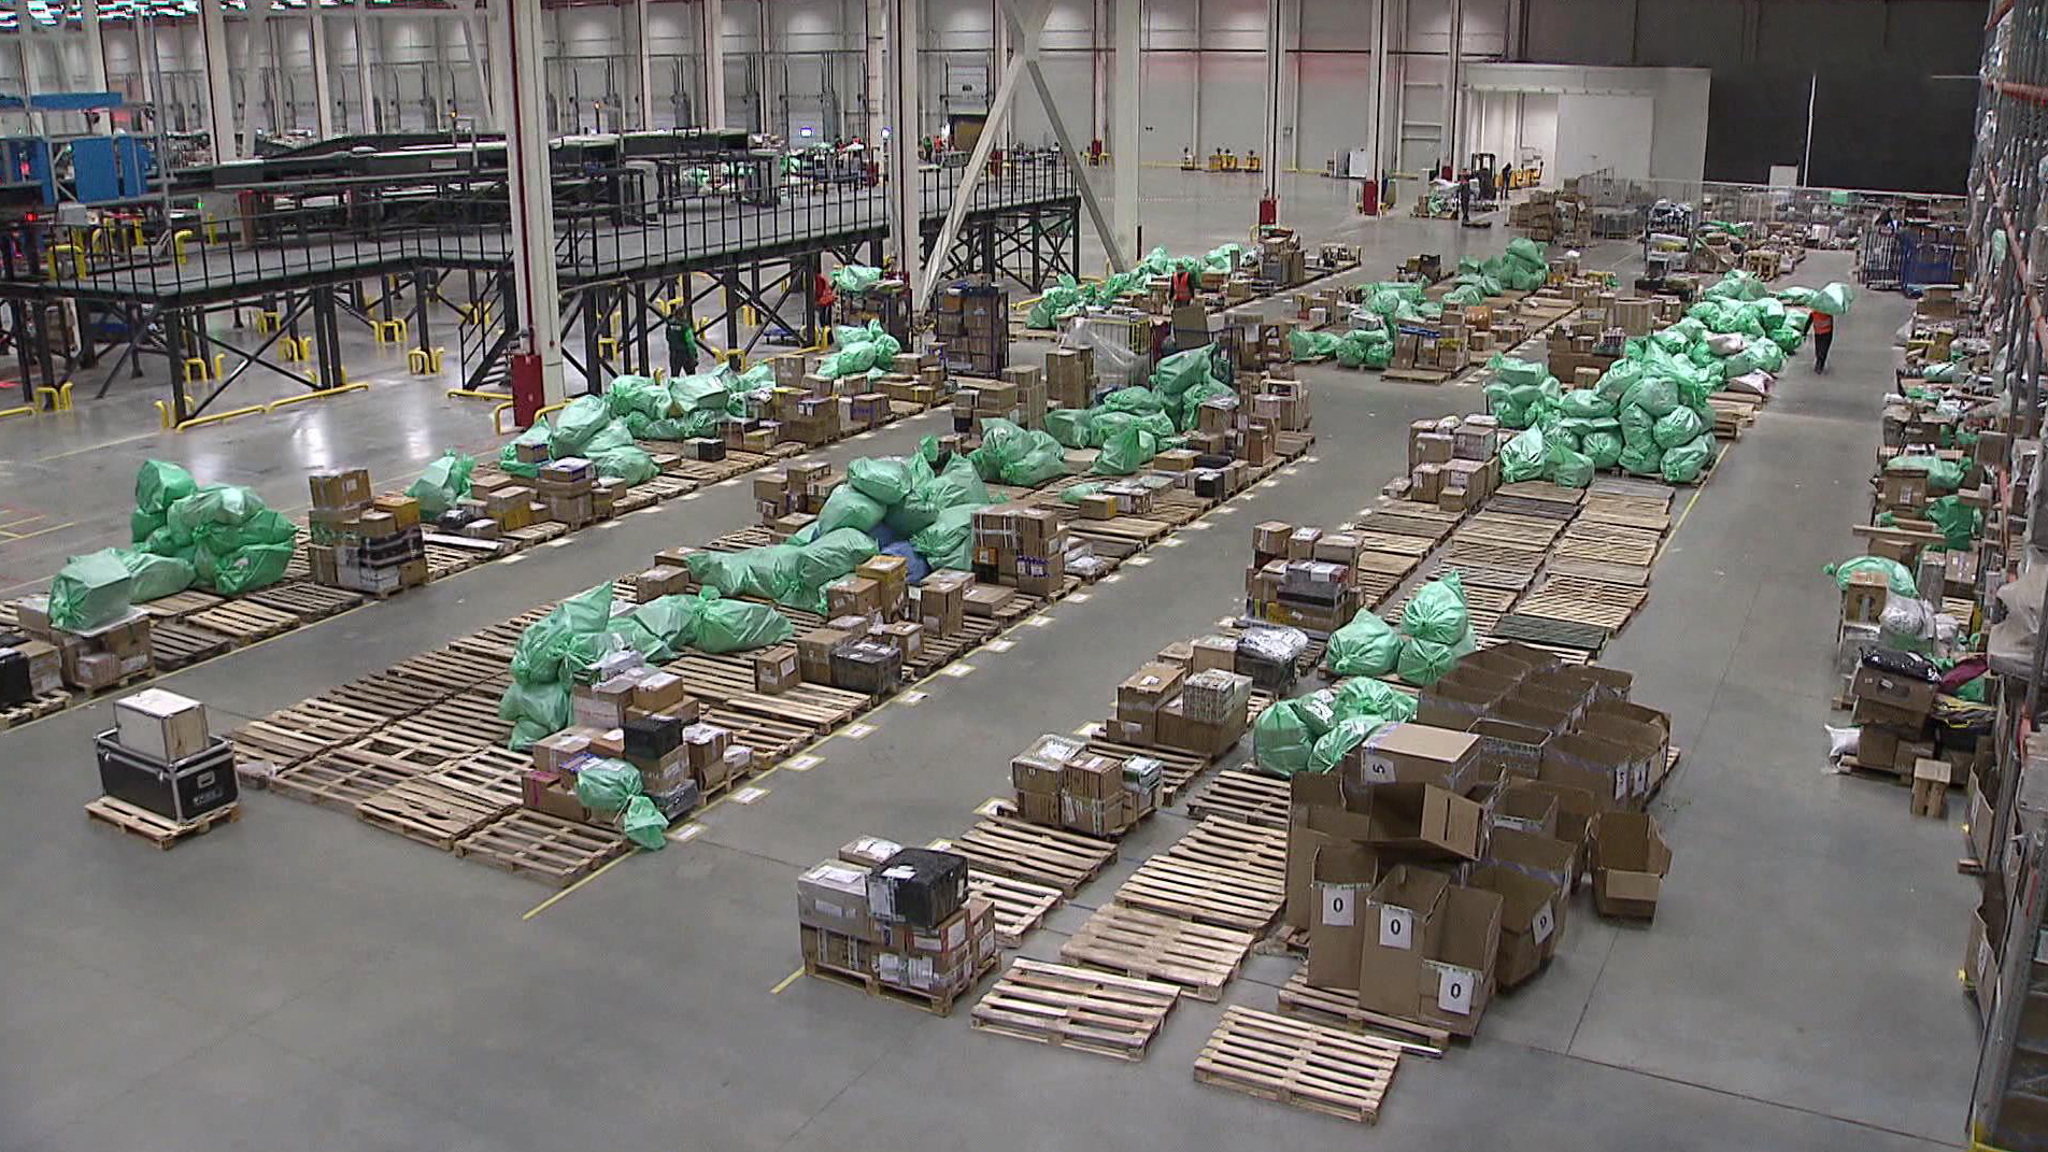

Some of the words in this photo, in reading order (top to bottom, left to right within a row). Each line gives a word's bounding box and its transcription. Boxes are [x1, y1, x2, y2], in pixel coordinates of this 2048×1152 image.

[1333, 897, 1344, 913] 0
[1390, 918, 1401, 935] 0
[1450, 982, 1461, 999] 0
